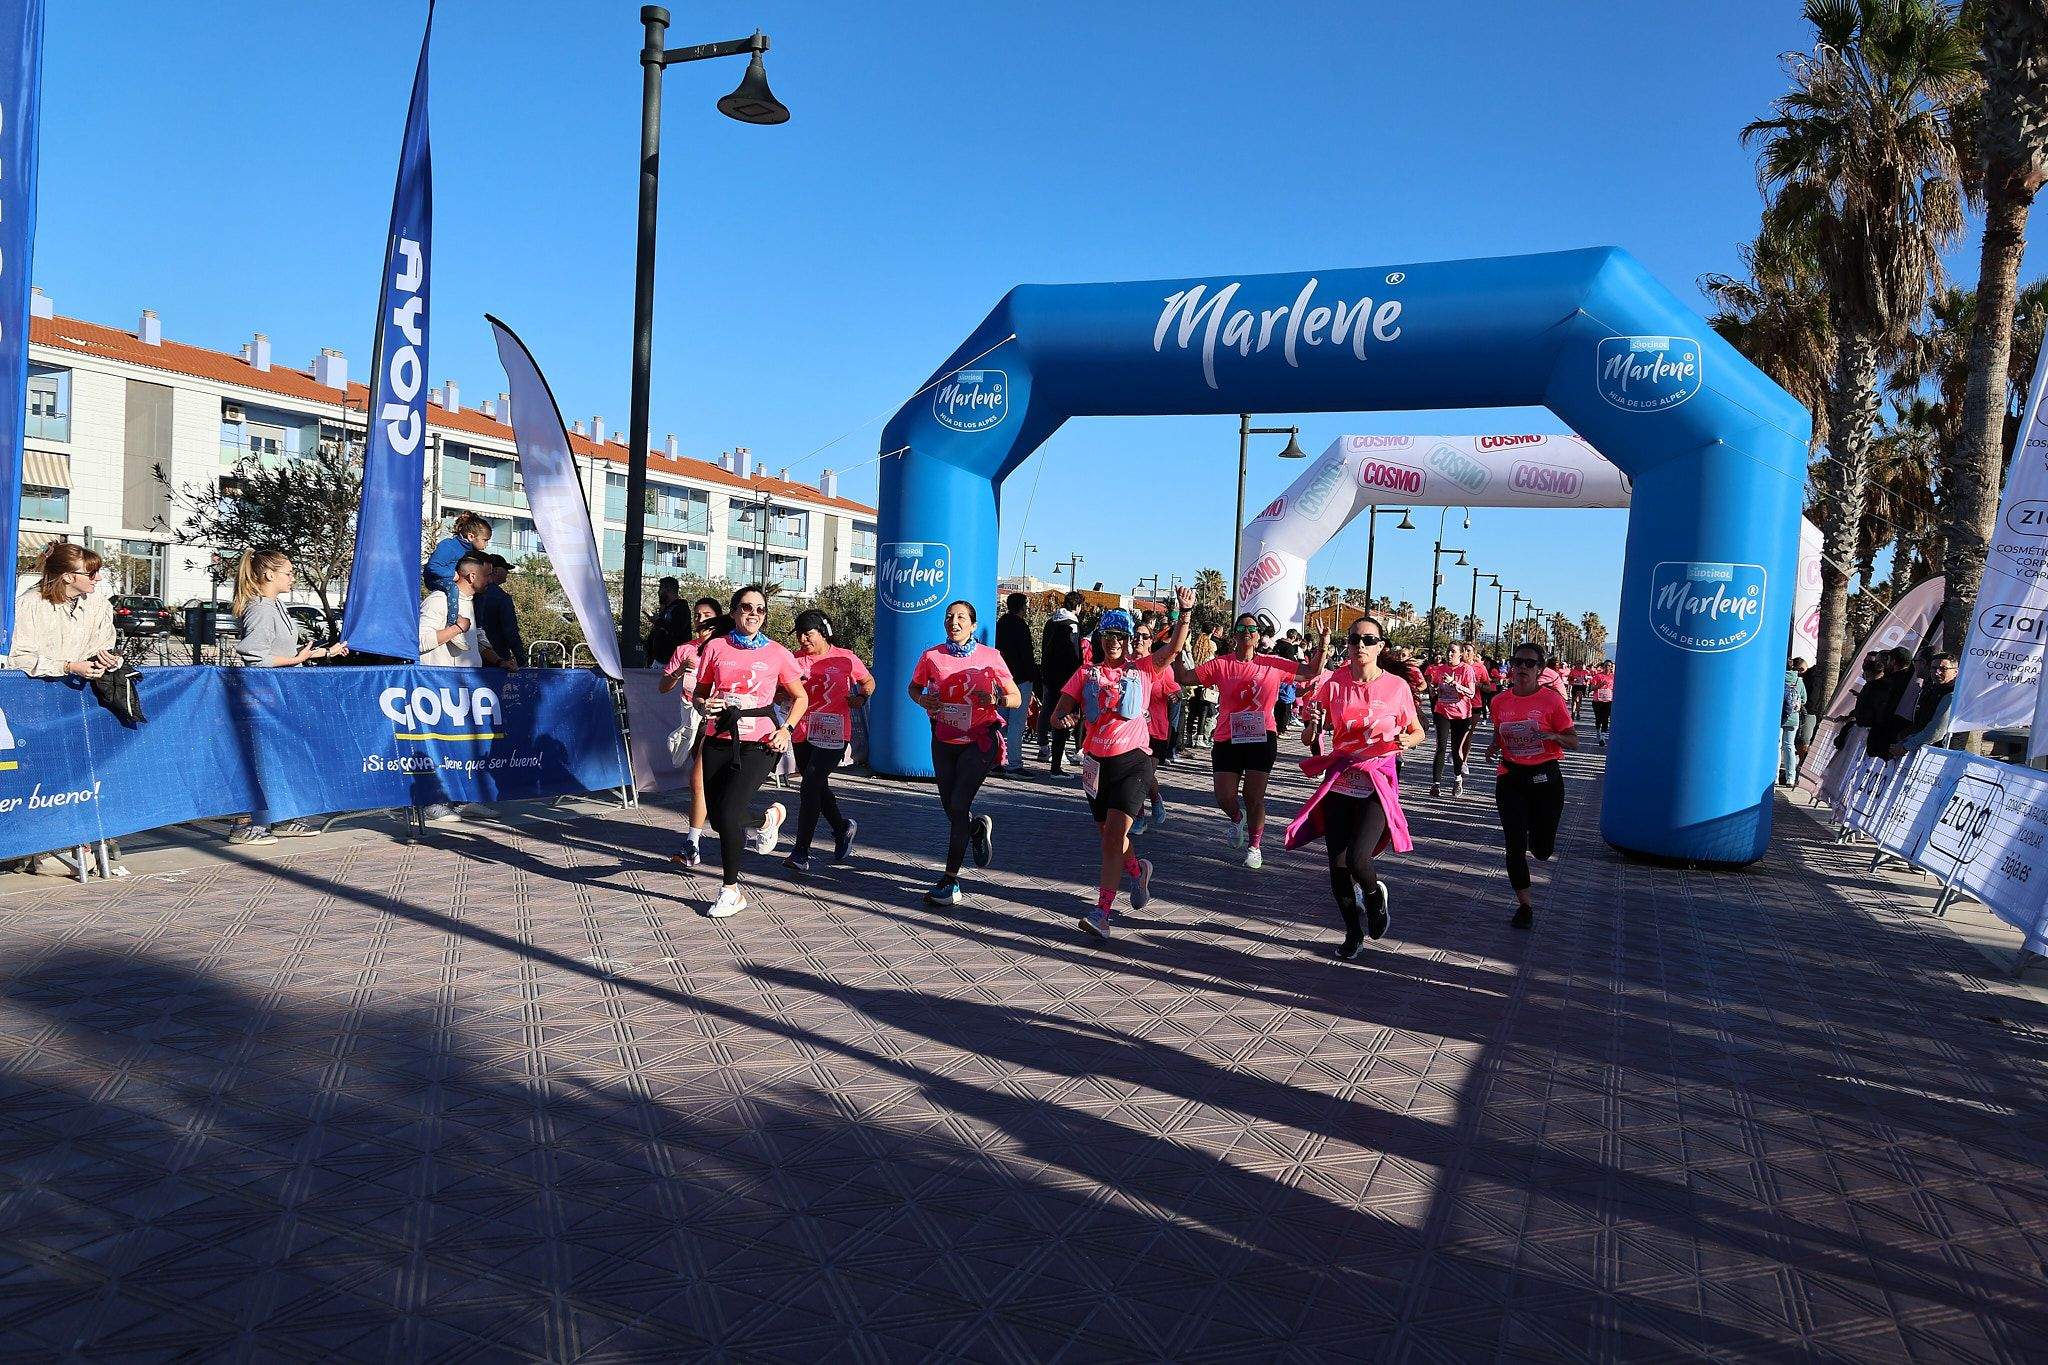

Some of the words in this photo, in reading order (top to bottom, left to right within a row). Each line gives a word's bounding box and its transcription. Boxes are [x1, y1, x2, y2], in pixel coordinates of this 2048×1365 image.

[381, 238, 423, 456] GOYA
[1154, 277, 1402, 389] Marlene
[1604, 352, 1695, 392] Marlene
[938, 383, 1003, 415] Marlene
[1608, 390, 1626, 404] HIJA
[1627, 399, 1639, 408] DE
[1660, 388, 1687, 406] ALPES
[1481, 435, 1541, 449] COSMO
[1363, 462, 1421, 494] COSMO
[1430, 445, 1487, 490] COSMO
[1514, 464, 1578, 495] COSMO
[882, 558, 944, 593] Marlene
[1657, 582, 1757, 627] Marlene
[1660, 623, 1678, 640] HIJA
[1680, 635, 1694, 645] DE
[1696, 638, 1716, 647] LOS
[1718, 629, 1748, 646] ALPES
[1969, 647, 2030, 662] COSMÉTICA
[1987, 672, 1994, 680] Y
[1996, 673, 2037, 686] CAPILAR
[379, 687, 502, 730] GOYA
[387, 759, 399, 771] es
[401, 757, 434, 771] GOYA
[465, 759, 485, 780] que
[489, 757, 508, 769] ser
[510, 750, 543, 768] bueno!
[0, 797, 22, 812] er
[28, 780, 102, 810] bueno!
